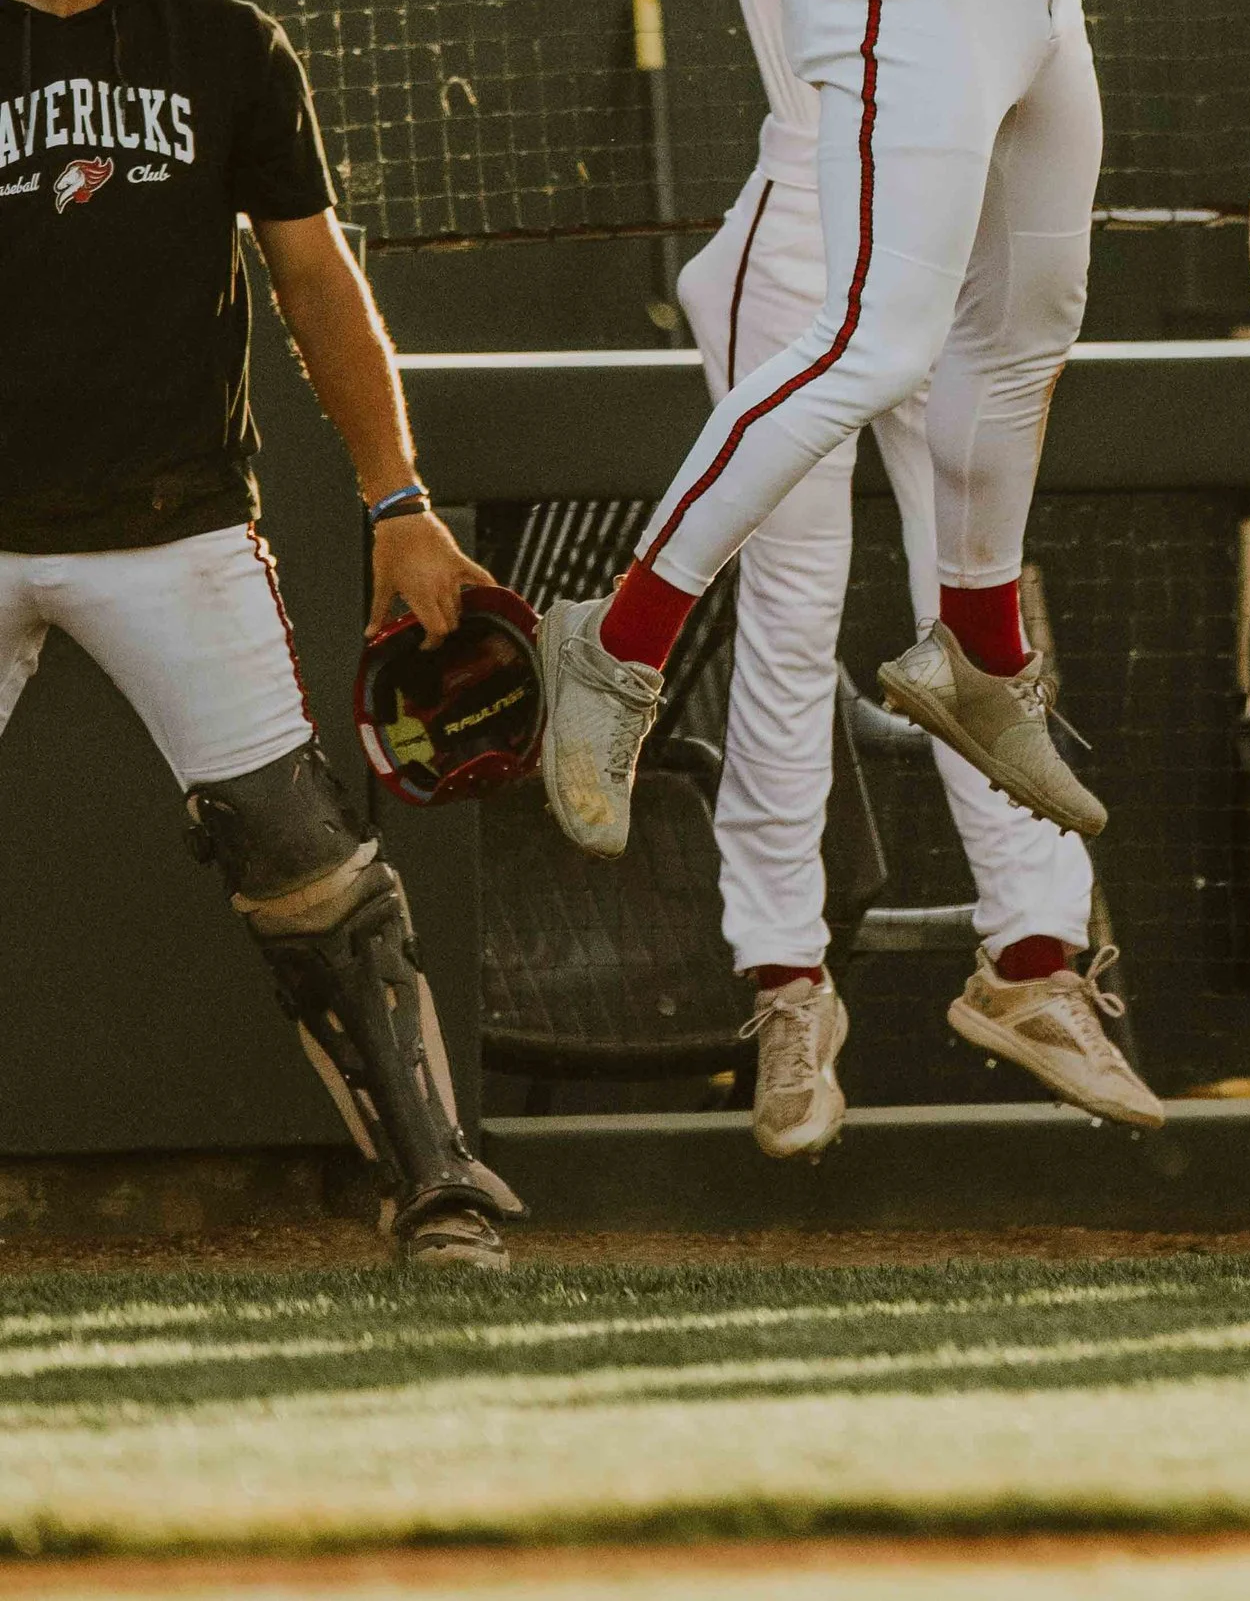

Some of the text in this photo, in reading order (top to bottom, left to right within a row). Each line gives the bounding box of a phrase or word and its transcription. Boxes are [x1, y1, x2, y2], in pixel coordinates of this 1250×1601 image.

[0, 78, 195, 168] AVERICKS
[0, 163, 171, 197] aseball Club
